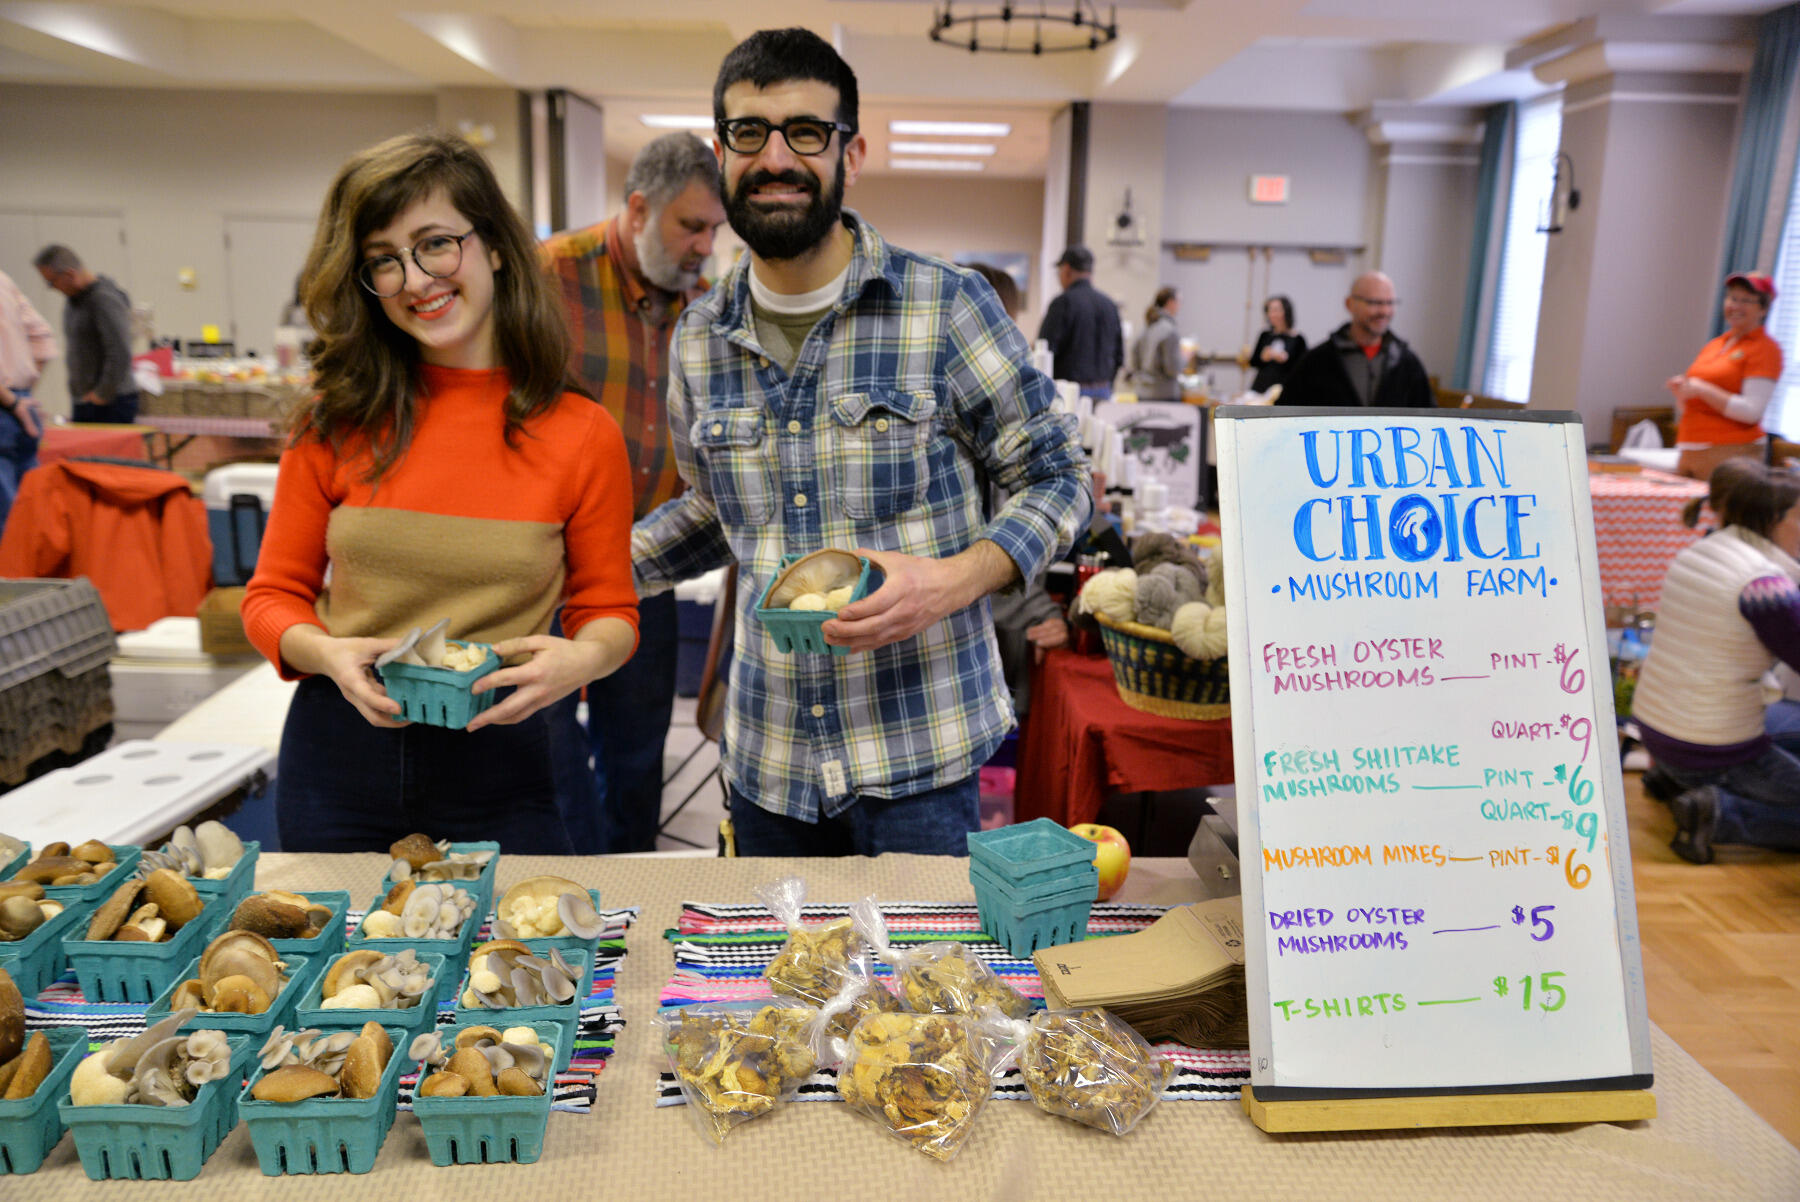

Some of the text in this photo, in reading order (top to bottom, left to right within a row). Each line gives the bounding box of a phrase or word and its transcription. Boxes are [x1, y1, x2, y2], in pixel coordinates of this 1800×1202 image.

[1299, 427, 1512, 489] URBAN
[1293, 493, 1540, 563] CHOICE
[1289, 566, 1548, 602] MUSHROOM FARM
[1263, 638, 1444, 673] FRESH OYSTER
[1273, 666, 1435, 695] MUSHROOMS
[1263, 744, 1460, 777] FRESH SHIITAKE
[1262, 772, 1400, 803] MUSHROOMS
[1263, 845, 1371, 872] MUSHROOM
[1383, 845, 1446, 867] MIXES
[1270, 905, 1555, 941] DRIED OYSTER $5
[1278, 931, 1409, 957] MUSHROOMS
[1274, 971, 1566, 1021] T-SHIRTS $15
